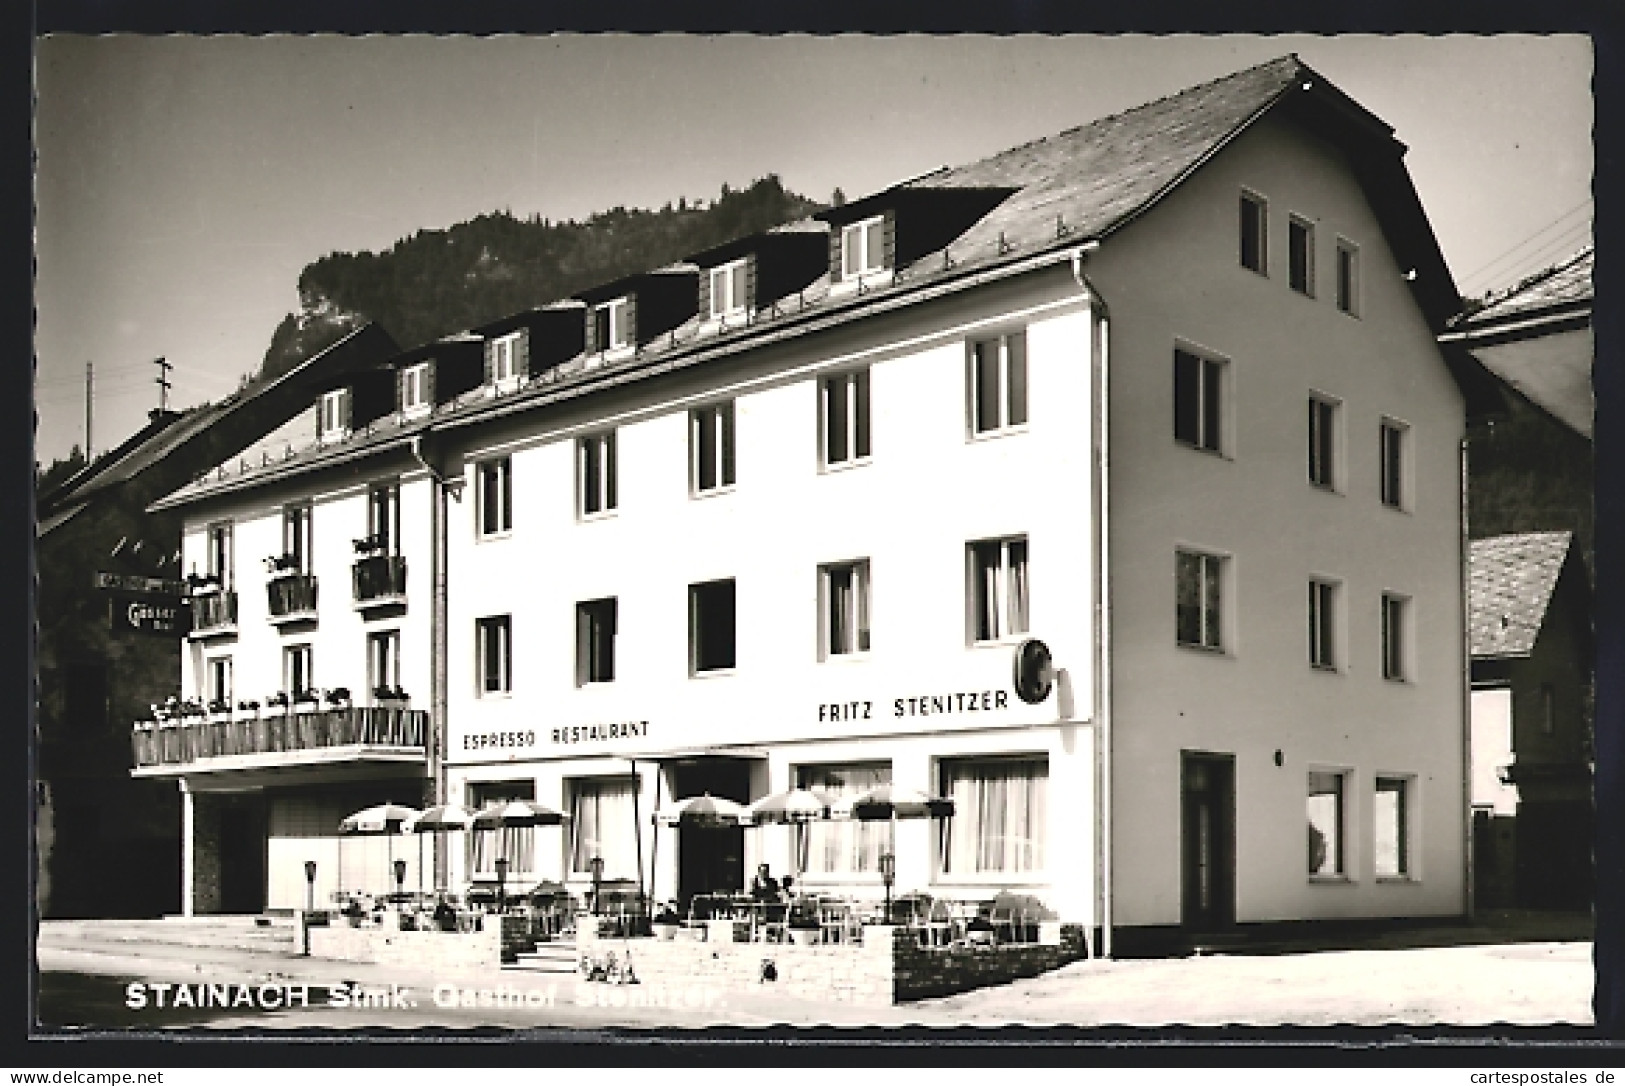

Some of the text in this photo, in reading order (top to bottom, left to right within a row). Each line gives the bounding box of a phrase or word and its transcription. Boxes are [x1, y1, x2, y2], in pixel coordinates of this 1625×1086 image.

[819, 690, 1008, 722] FRITZ STENITZER
[463, 720, 650, 750] ESPRESSO RESTAURANT
